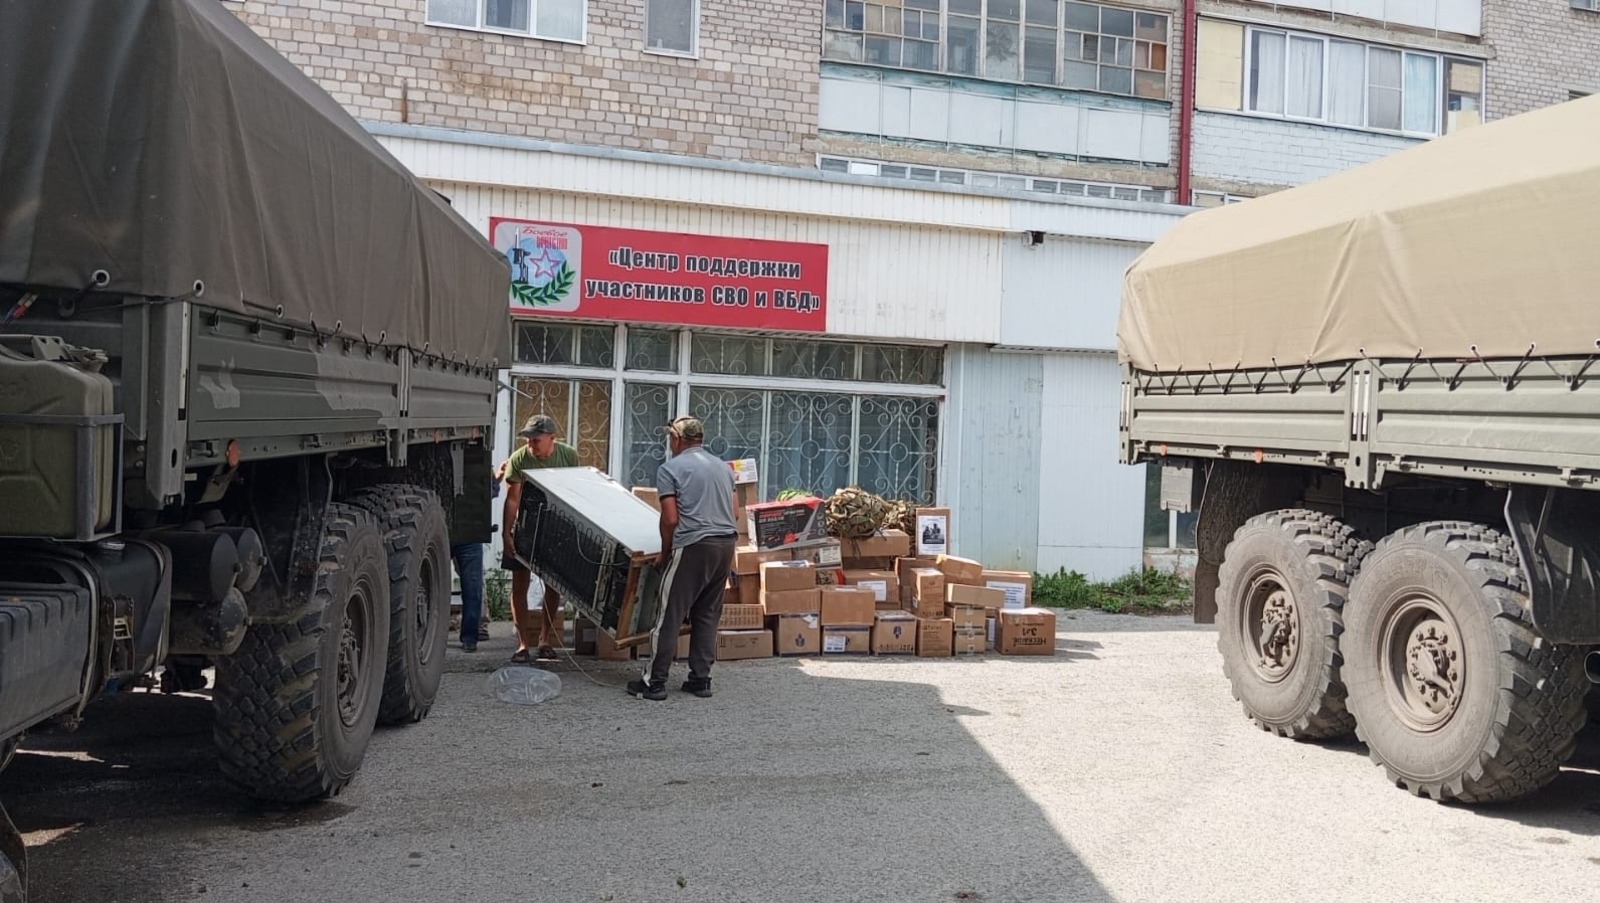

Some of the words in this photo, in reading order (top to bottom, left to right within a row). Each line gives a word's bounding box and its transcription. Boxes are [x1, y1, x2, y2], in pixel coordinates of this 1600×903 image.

[609, 248, 678, 271] «Центр
[686, 256, 800, 279] поддержки
[586, 279, 704, 304] участников
[712, 287, 748, 307] СВО
[755, 291, 767, 308] и
[774, 291, 820, 313] ВБД»
